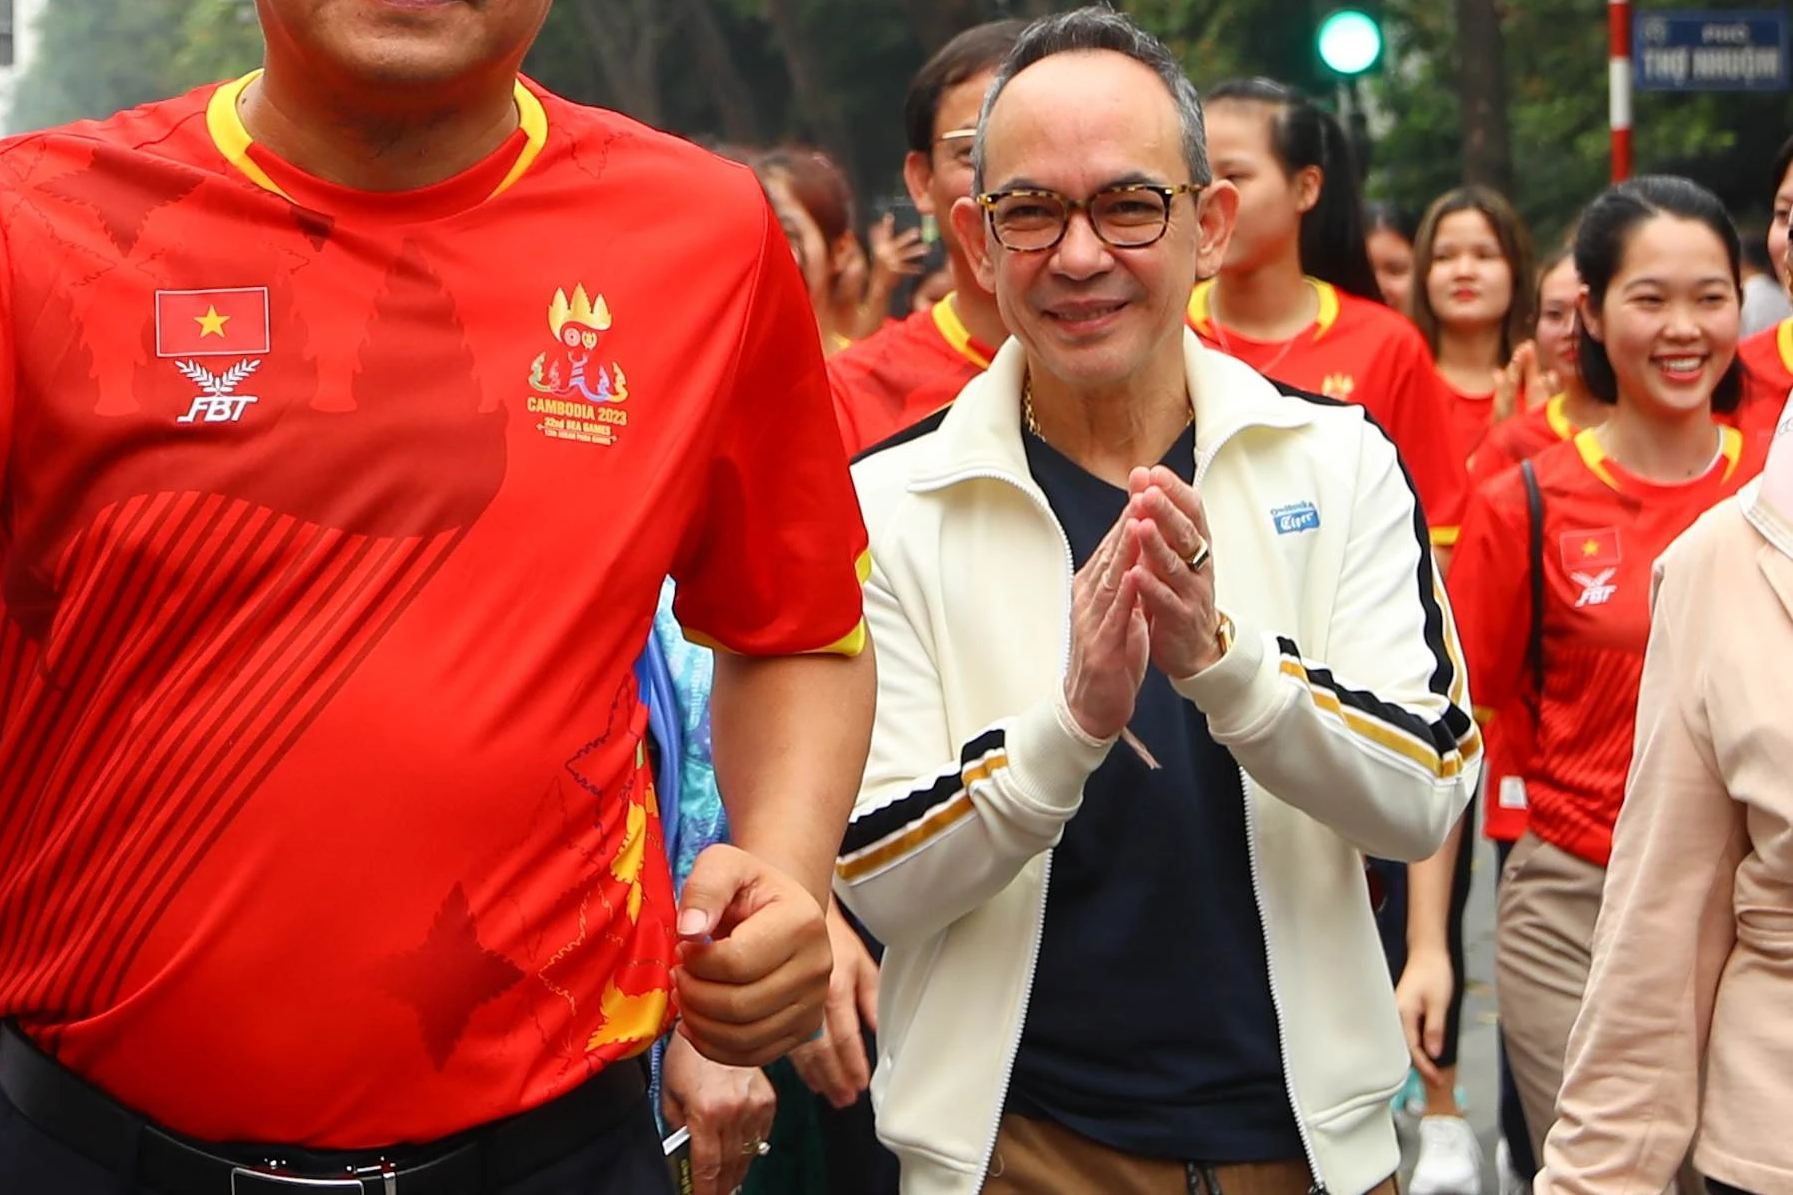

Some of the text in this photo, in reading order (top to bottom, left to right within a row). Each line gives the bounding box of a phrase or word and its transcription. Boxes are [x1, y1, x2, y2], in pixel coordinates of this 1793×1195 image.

[176, 395, 259, 422] FBT
[527, 397, 627, 426] CAMBODIA 2023
[1575, 584, 1617, 608] FBT
